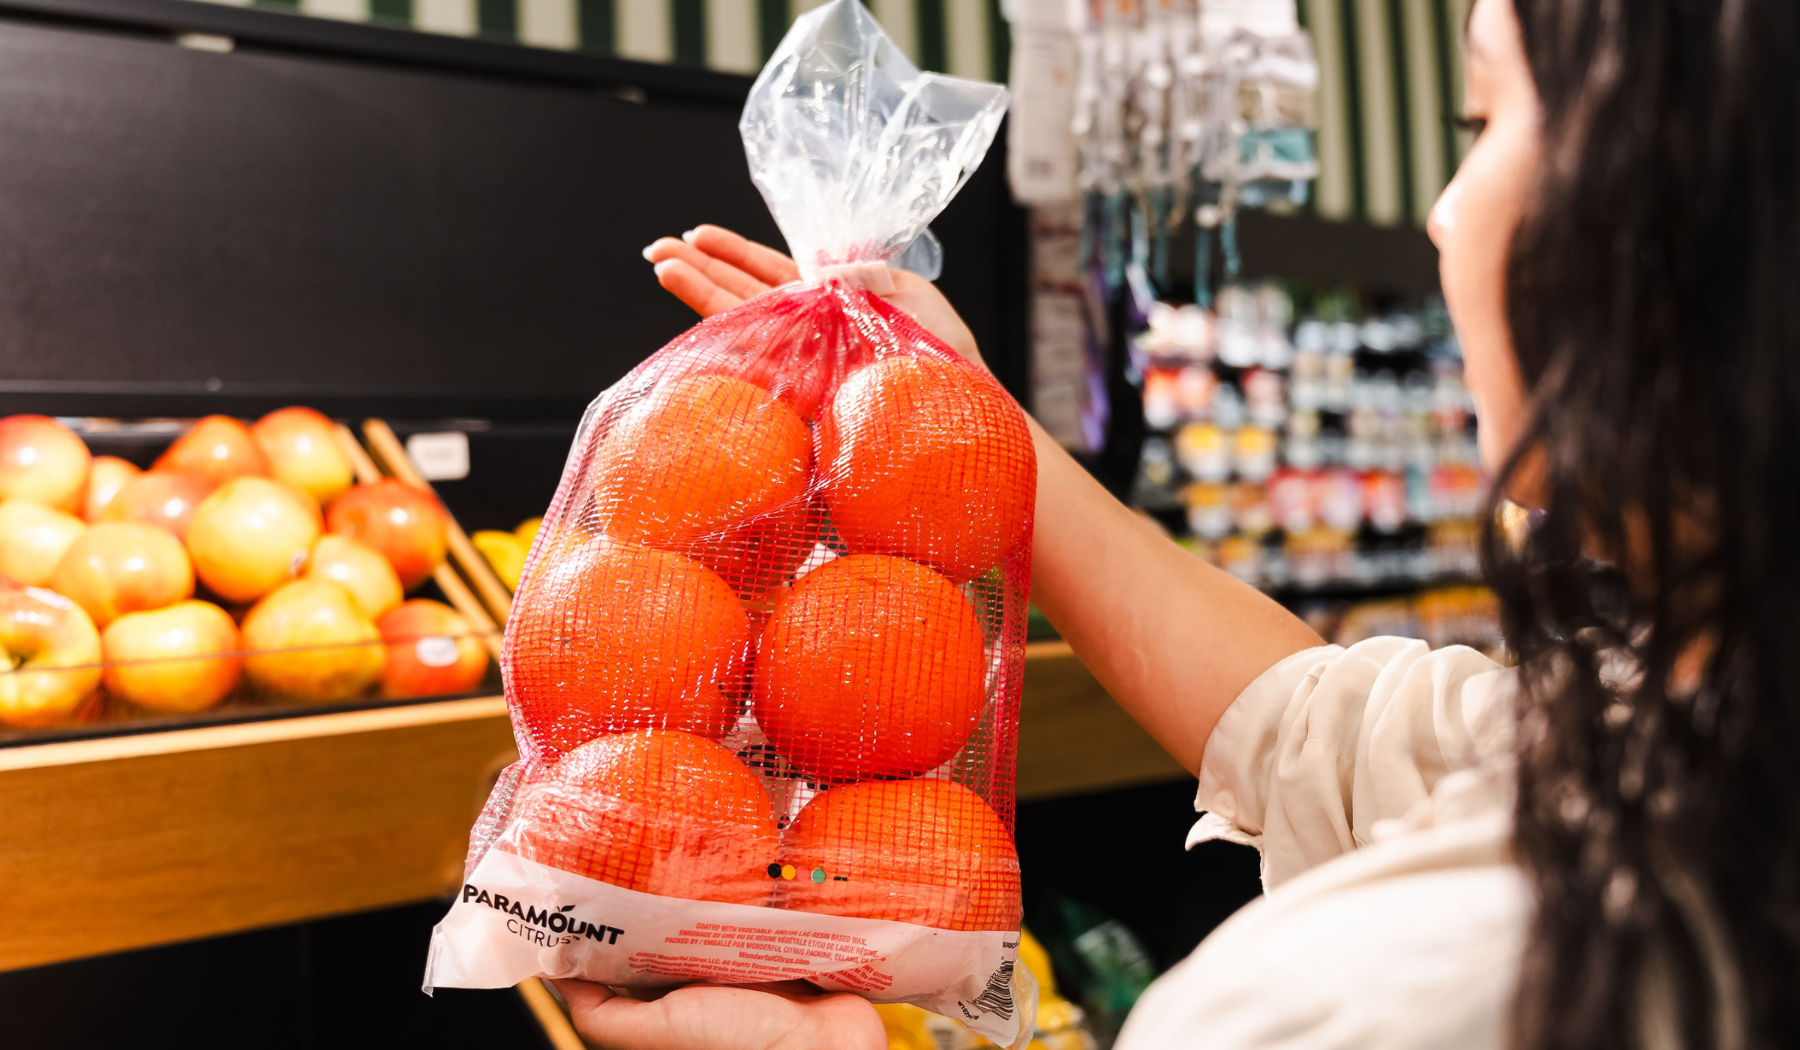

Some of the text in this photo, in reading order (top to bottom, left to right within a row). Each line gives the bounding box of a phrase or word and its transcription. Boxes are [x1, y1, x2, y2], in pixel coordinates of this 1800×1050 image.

[463, 884, 625, 945] PARAMOUNT
[696, 923, 720, 931] COATED
[799, 931, 830, 940] LAC-RESIN
[831, 933, 851, 942] BASED
[852, 936, 867, 946] WAX.
[755, 934, 776, 942] RÉSINE
[778, 936, 808, 947] VÉGÉTALE
[808, 939, 826, 949] ET/OU
[826, 942, 835, 950] DE
[836, 944, 856, 954] LAQUE
[856, 946, 878, 957] RÉSINE.
[732, 940, 745, 949] PAR
[746, 941, 782, 953] WONDERFUL
[783, 946, 805, 956] CITRUS
[805, 949, 833, 961] PACKING,
[834, 953, 859, 964] DELANO,
[739, 952, 810, 965] WonderfulCitrus.com
[731, 960, 750, 968] Rights
